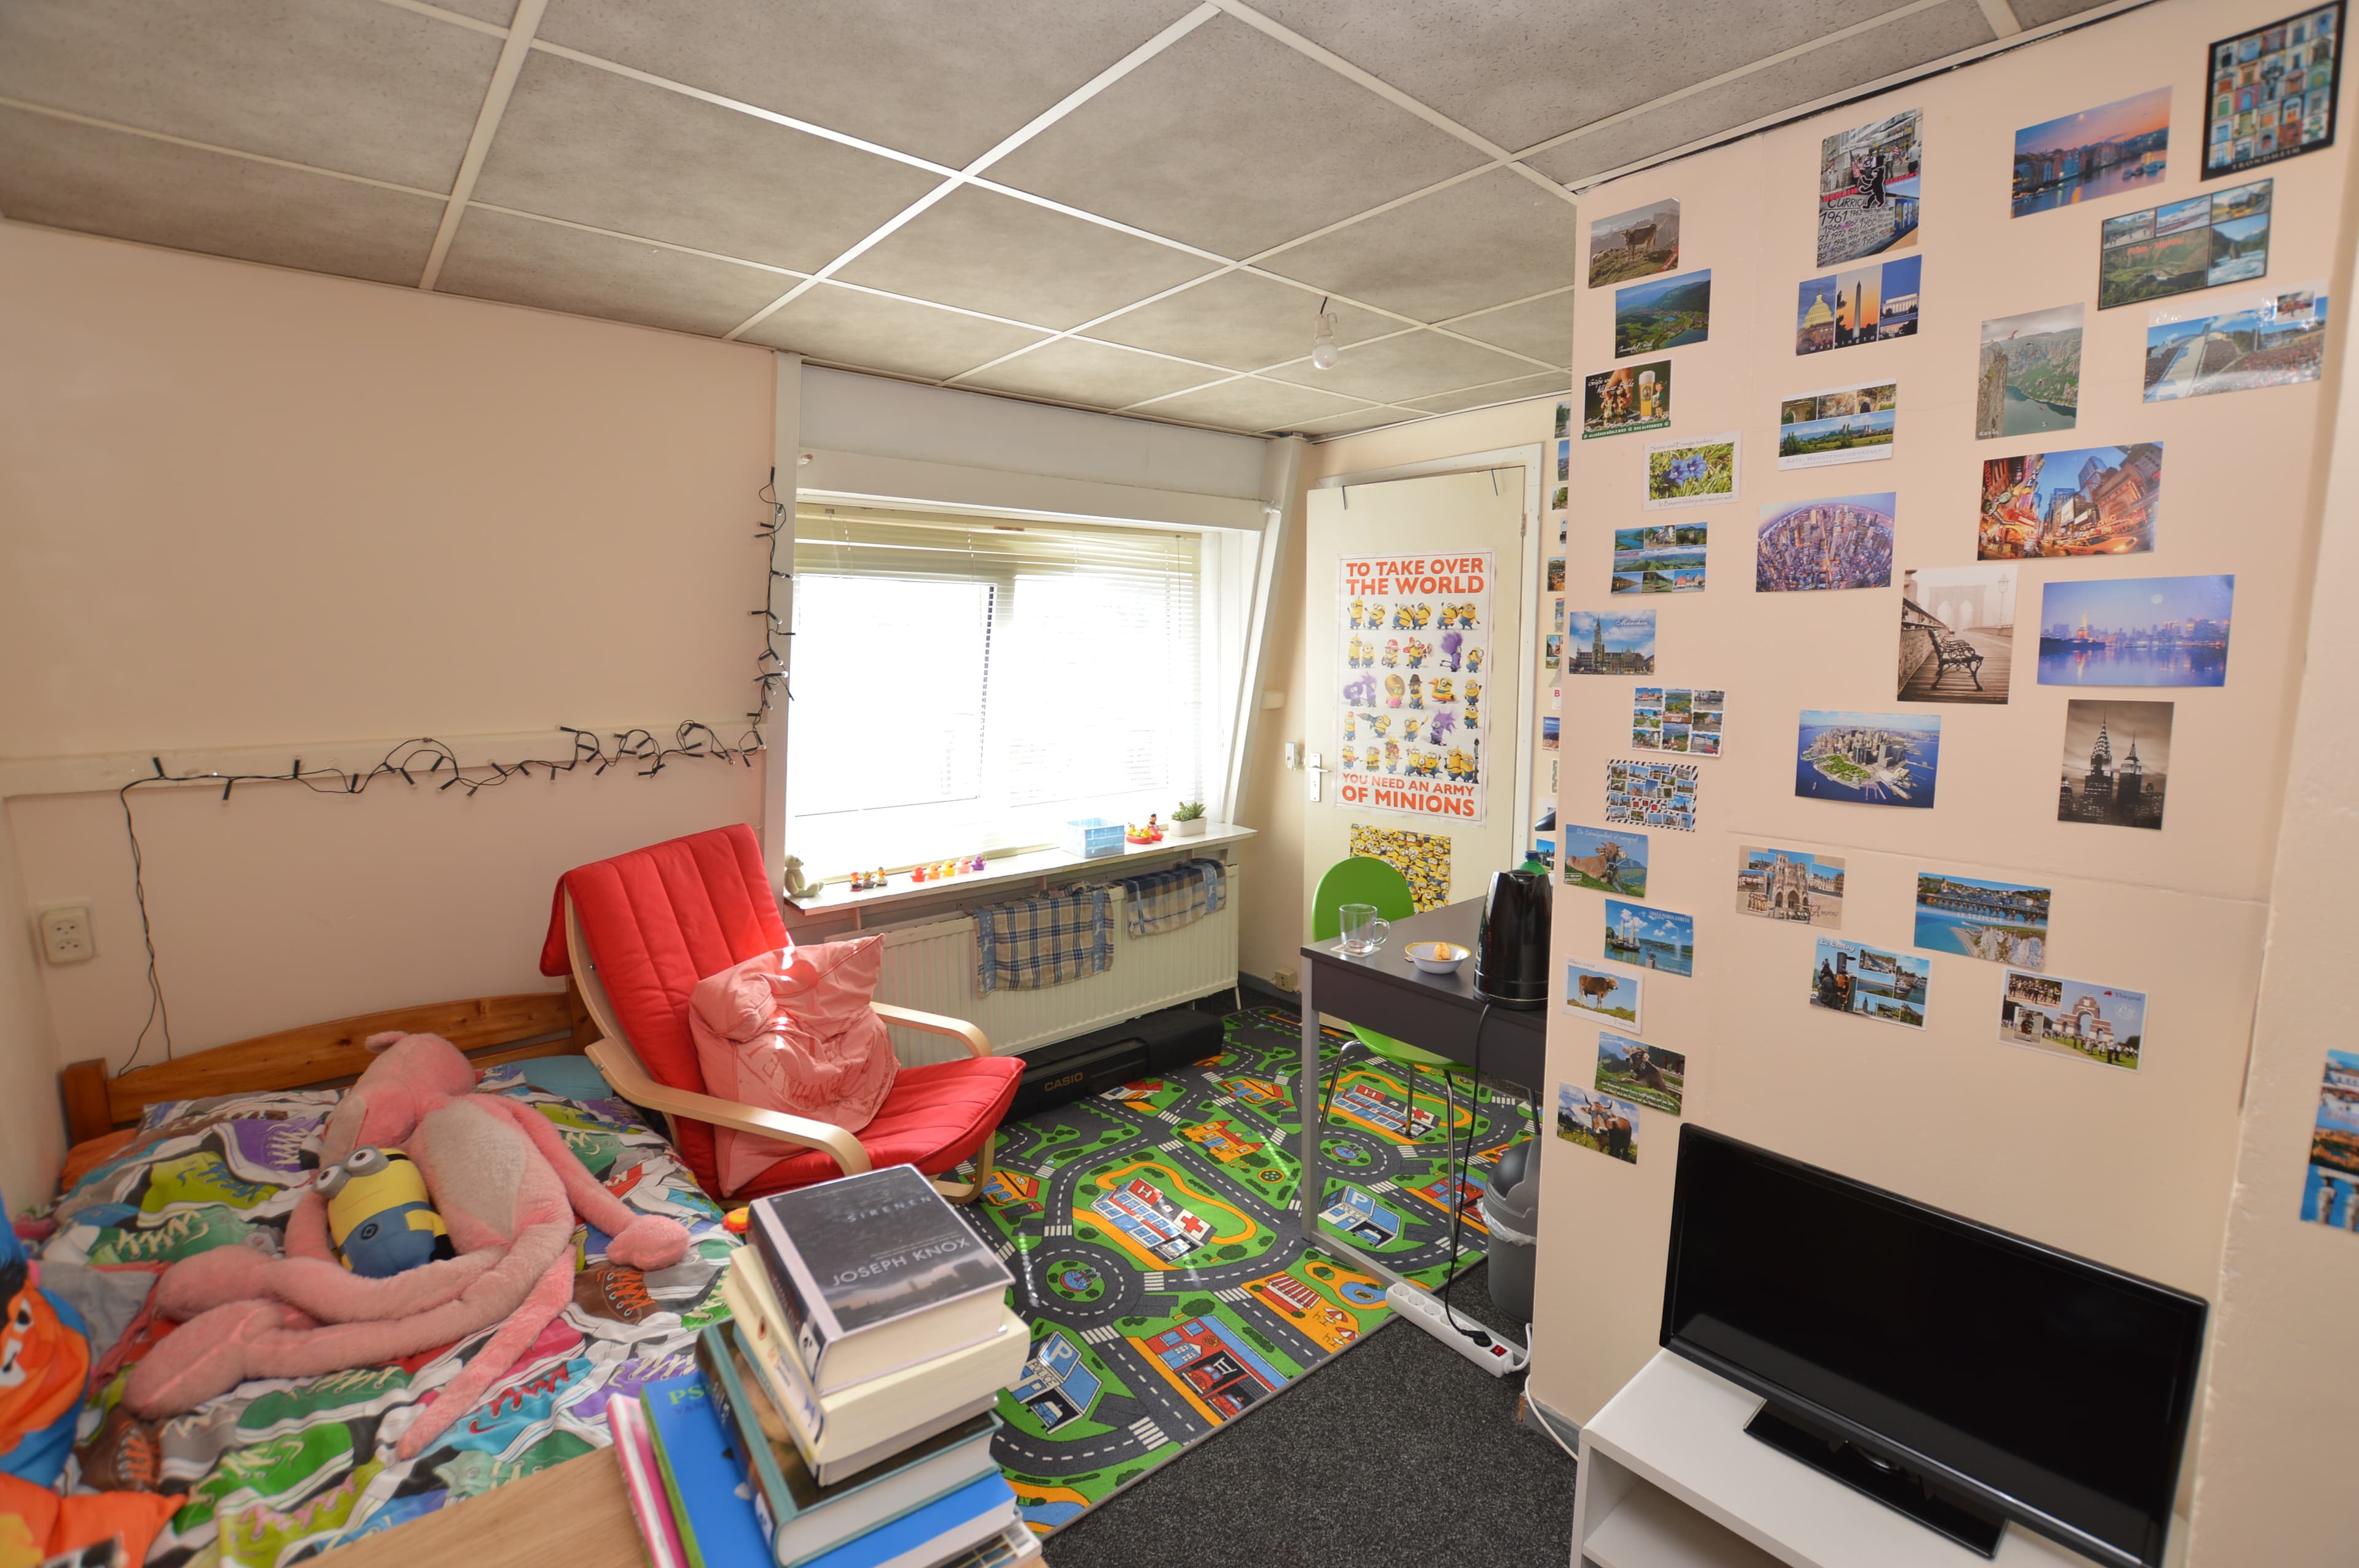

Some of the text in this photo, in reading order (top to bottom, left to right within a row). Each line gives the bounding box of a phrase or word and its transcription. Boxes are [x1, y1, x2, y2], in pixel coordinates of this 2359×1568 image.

[2232, 146, 2301, 170] TRONDHEIM
[1819, 210, 1848, 226] 1961
[1346, 558, 1484, 577] TO TAKE OVER
[1346, 575, 1485, 596] THE WORLD
[1343, 773, 1475, 797] YOU NEED AN ARMY
[1342, 785, 1475, 817] OF MINIONS
[1044, 1072, 1084, 1091] CASIO
[1137, 1185, 1153, 1199] H
[1351, 1192, 1369, 1204] P
[847, 1196, 932, 1223] SIRENEN
[832, 1255, 907, 1287] JOSEPH
[912, 1237, 971, 1262] KNOX
[1049, 1340, 1073, 1362] P
[1028, 1361, 1058, 1387] POLICE
